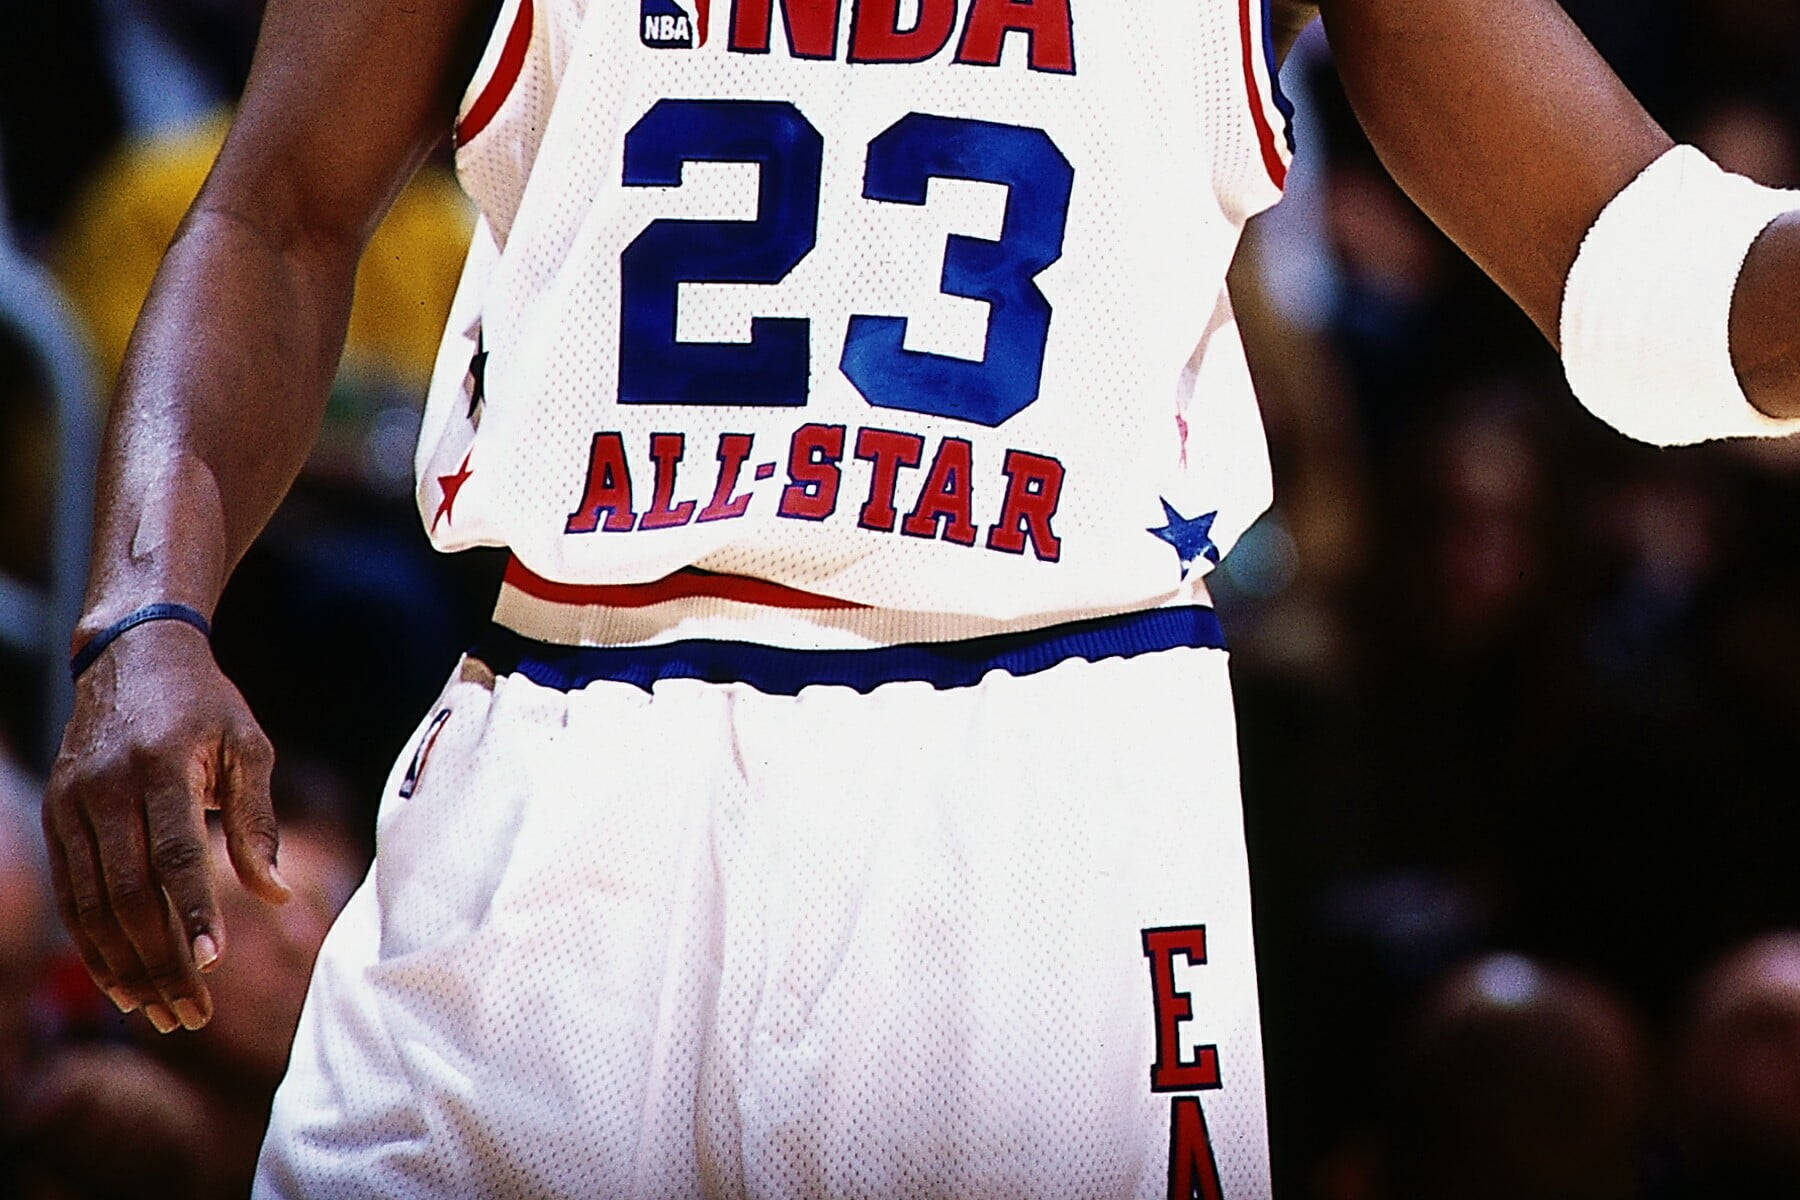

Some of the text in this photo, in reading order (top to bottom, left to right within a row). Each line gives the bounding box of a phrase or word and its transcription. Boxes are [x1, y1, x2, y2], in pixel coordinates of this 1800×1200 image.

[644, 15, 690, 41] NBA
[617, 98, 1076, 428] 23
[565, 422, 1066, 563] ALL-STAR
